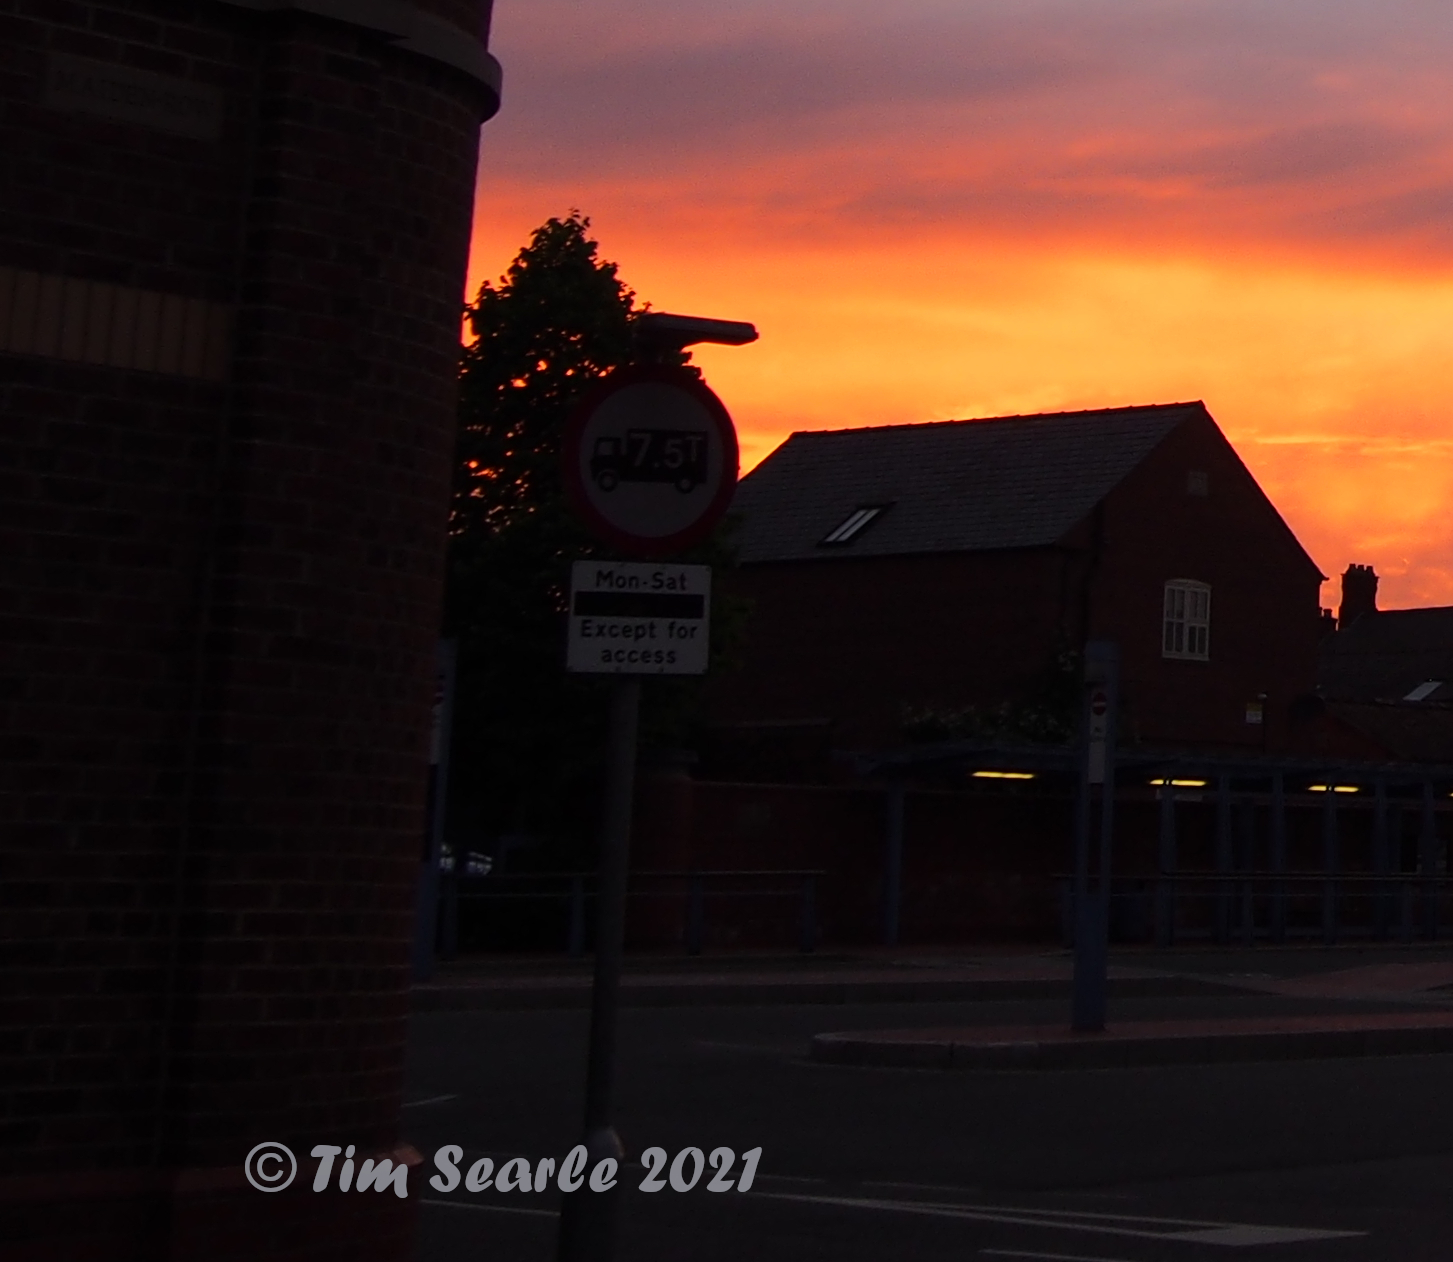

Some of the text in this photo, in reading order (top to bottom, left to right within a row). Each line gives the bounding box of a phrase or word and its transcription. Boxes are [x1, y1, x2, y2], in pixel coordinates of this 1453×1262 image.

[629, 431, 703, 469] 7.5T
[581, 619, 698, 641] Except for
[601, 649, 676, 664] access
